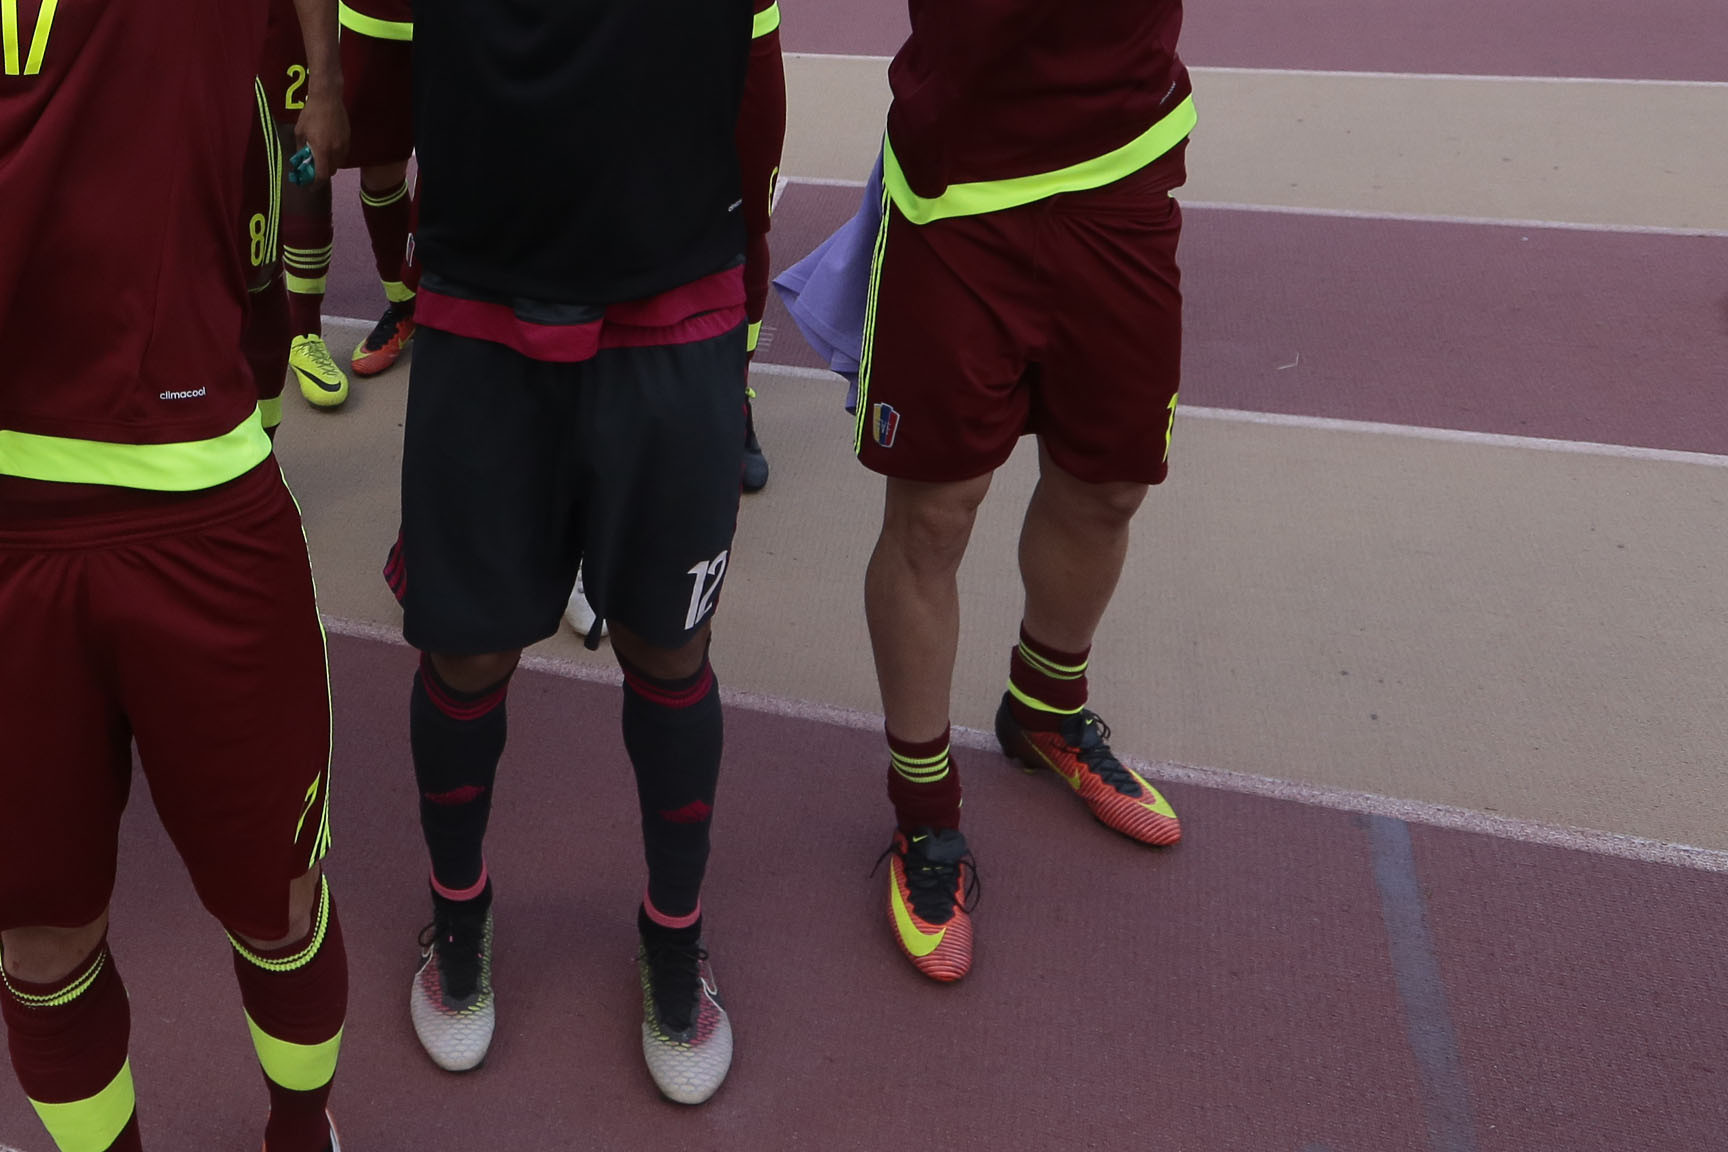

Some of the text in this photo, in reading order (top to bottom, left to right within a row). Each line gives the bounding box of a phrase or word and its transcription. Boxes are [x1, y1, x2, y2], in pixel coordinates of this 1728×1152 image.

[285, 65, 310, 109] 2
[249, 213, 265, 266] 8
[159, 386, 207, 400] climacool
[684, 550, 725, 630] 12
